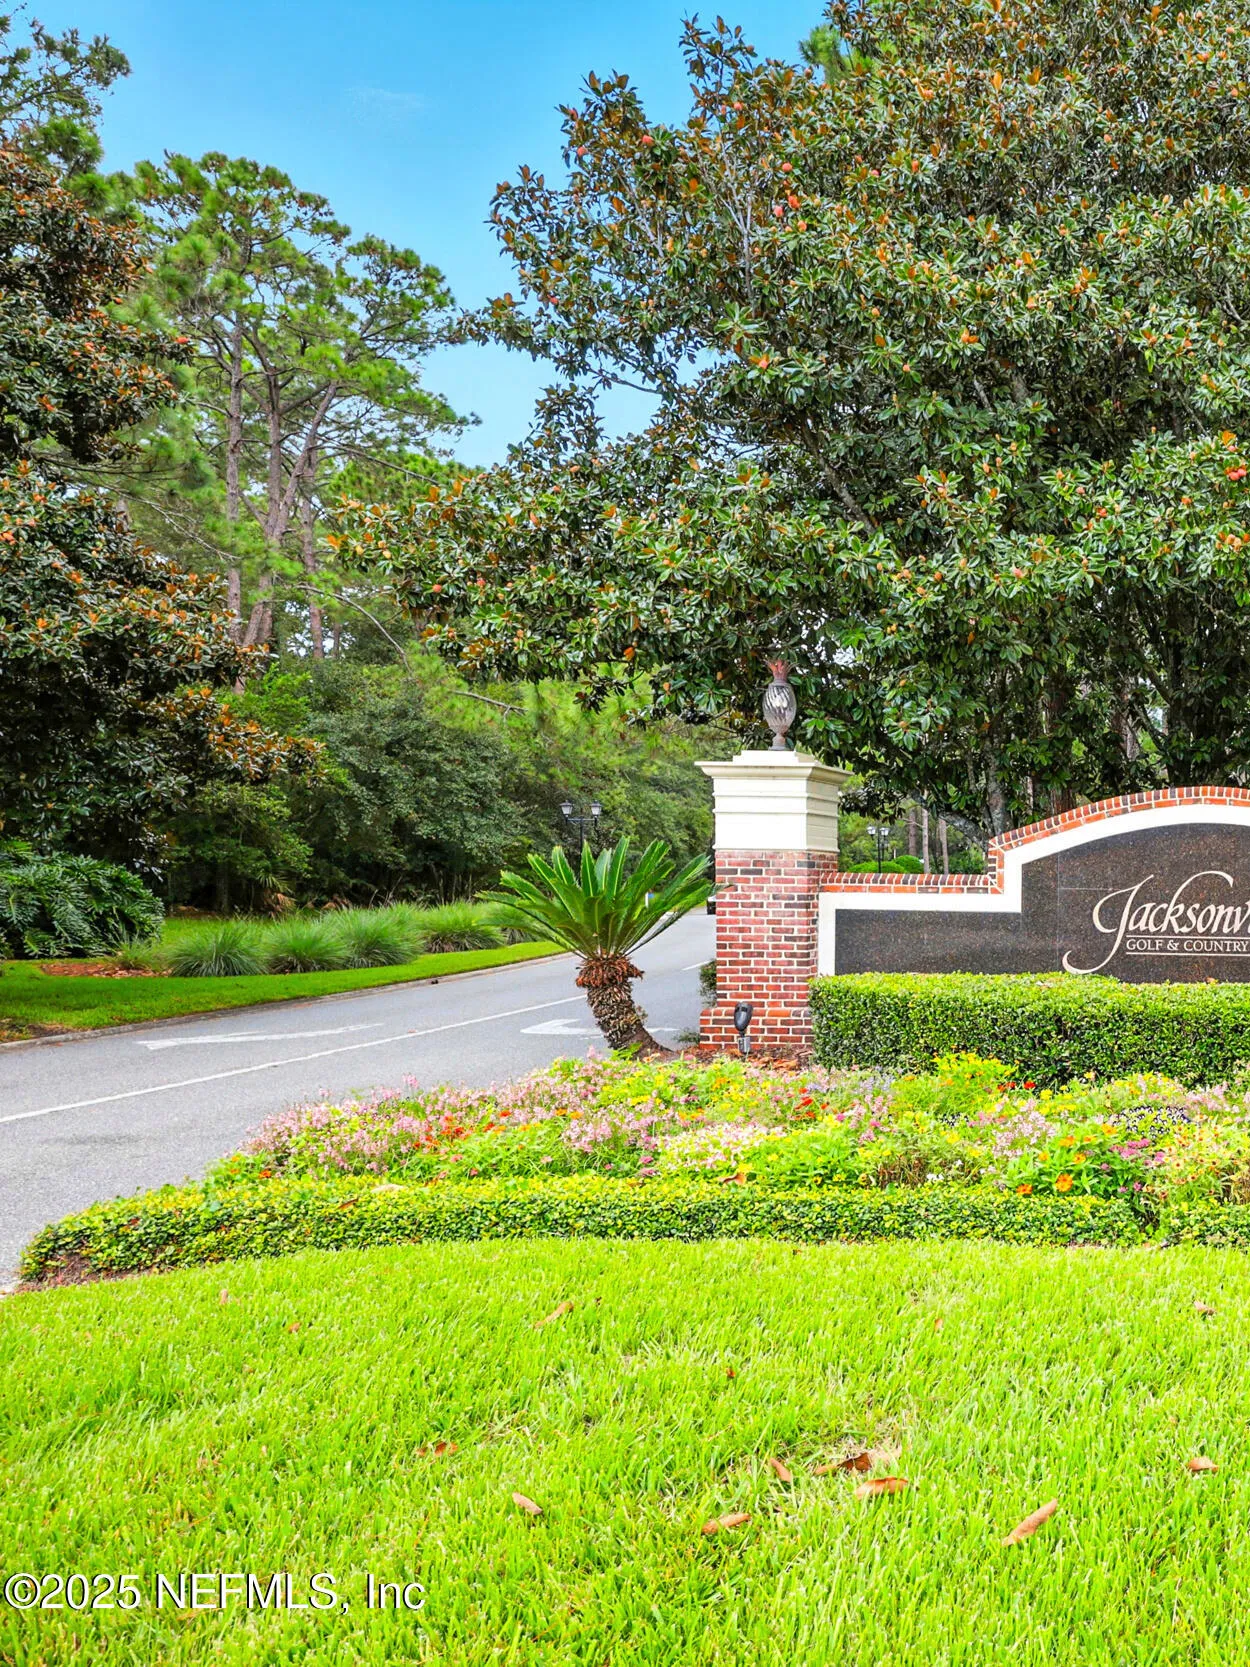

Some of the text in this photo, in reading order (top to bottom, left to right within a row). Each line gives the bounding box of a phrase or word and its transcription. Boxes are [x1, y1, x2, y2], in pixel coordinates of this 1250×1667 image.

[1126, 938, 1163, 951] GOLF
[1167, 940, 1179, 951] &
[1184, 940, 1249, 952] COUNTRY
